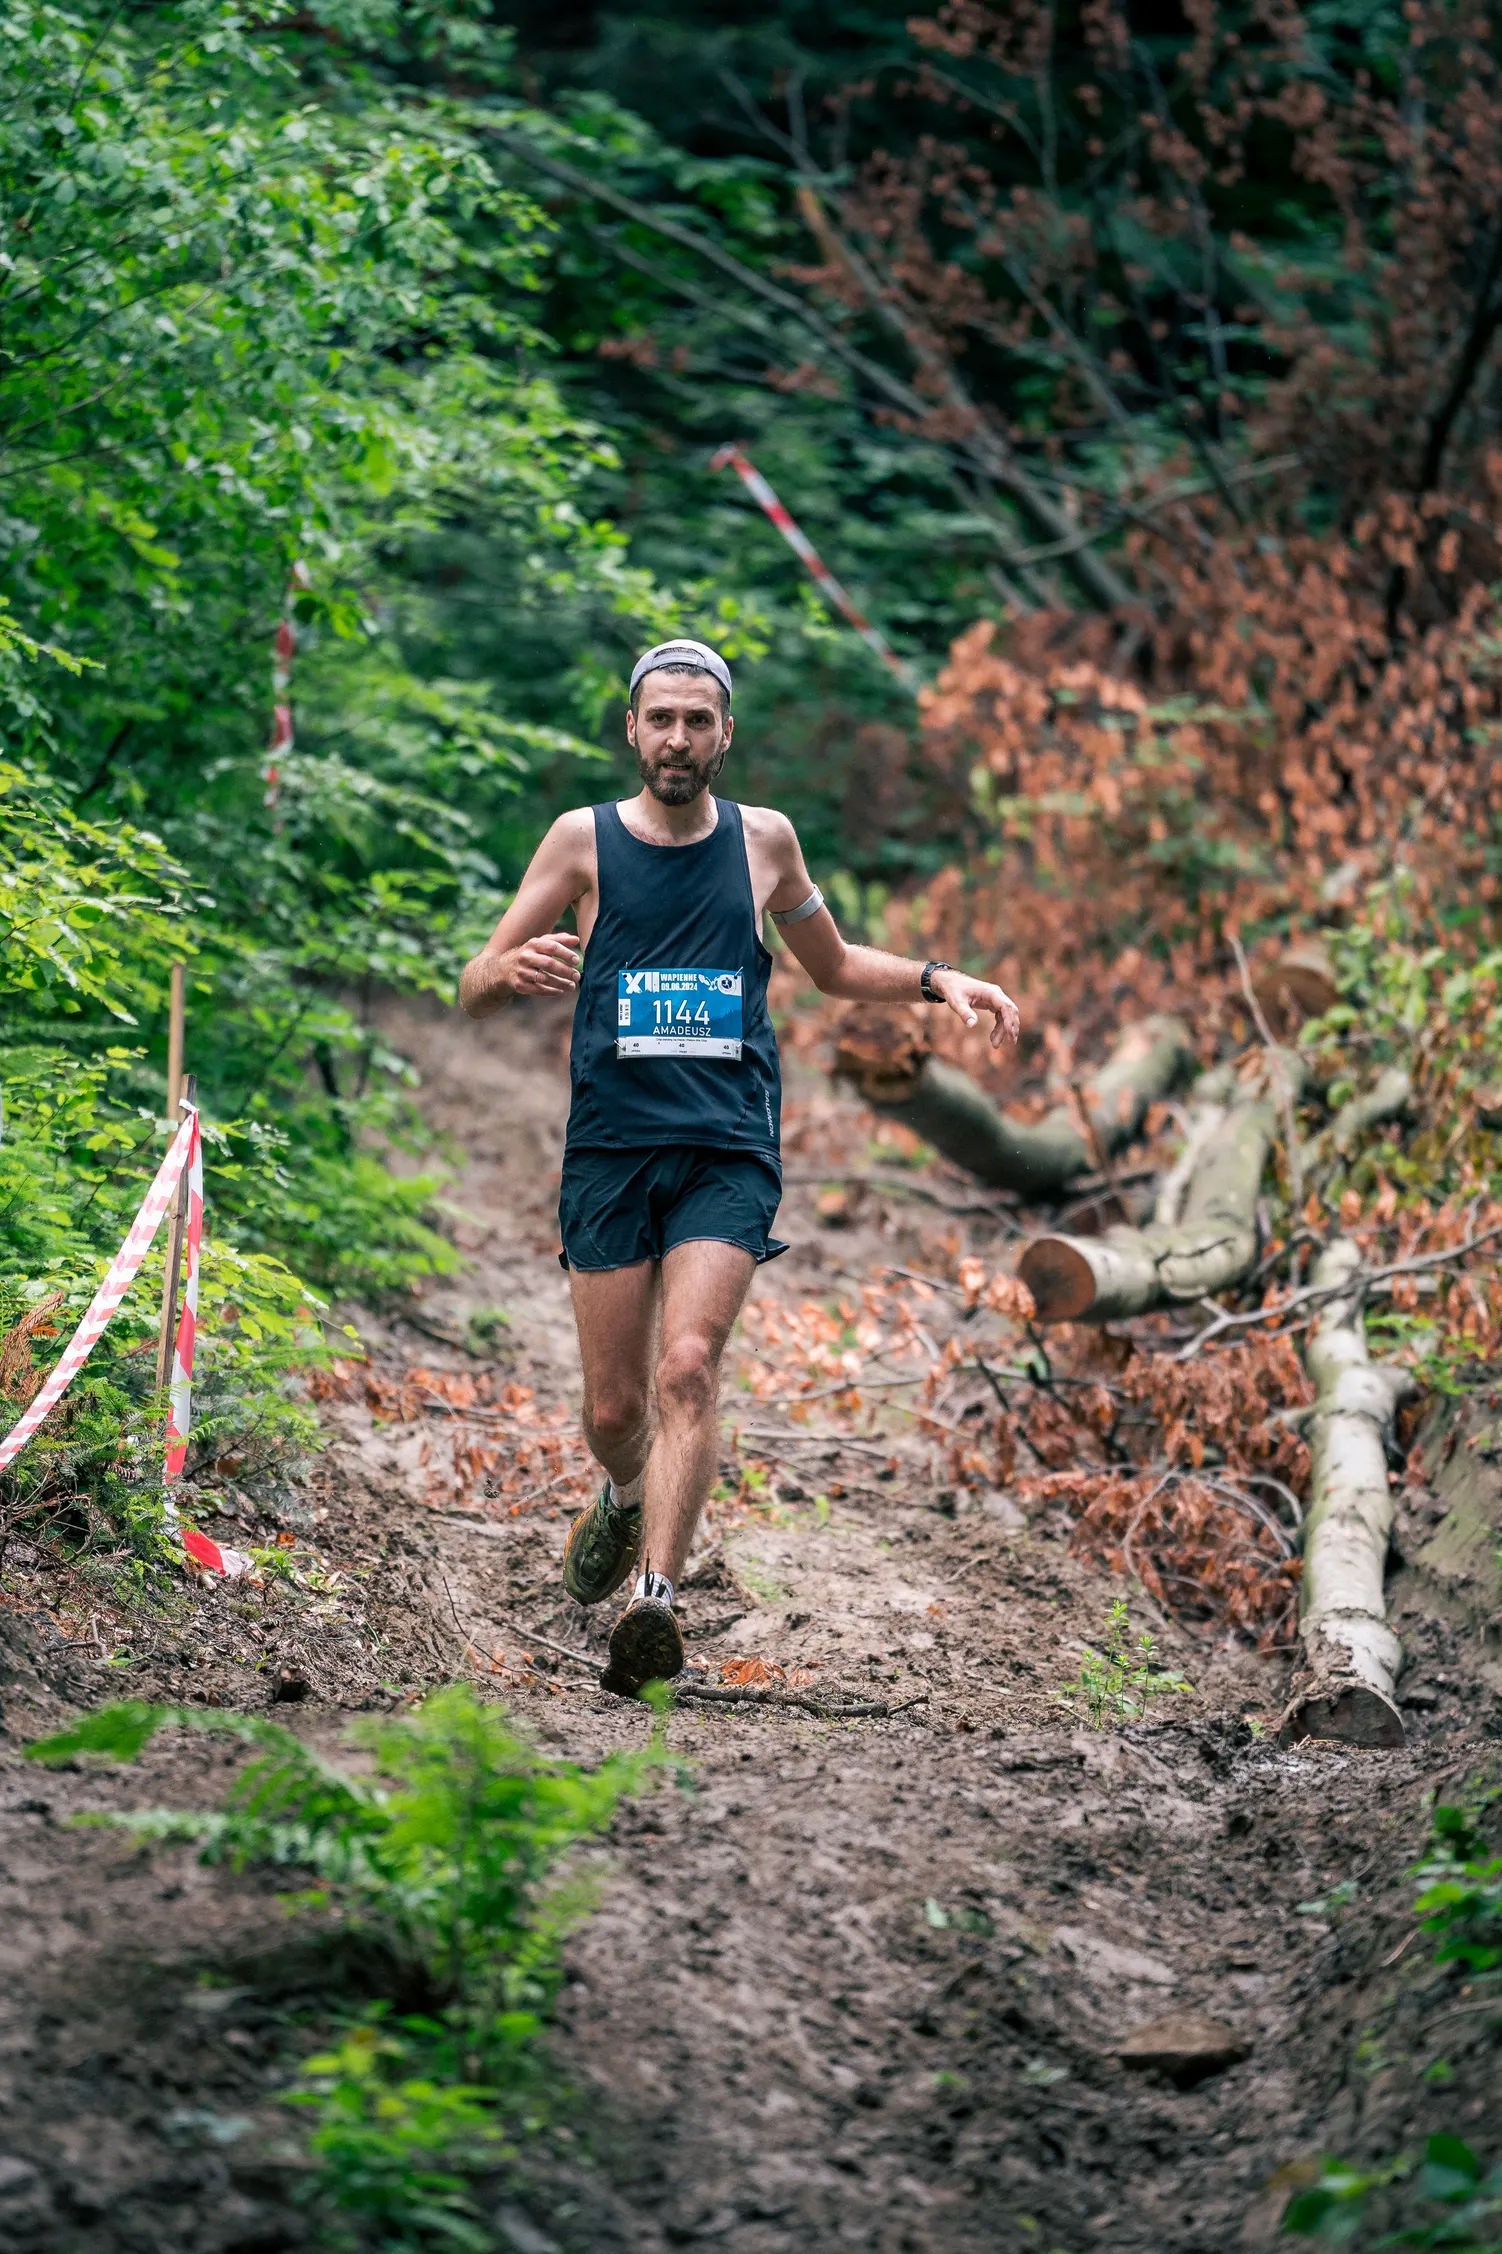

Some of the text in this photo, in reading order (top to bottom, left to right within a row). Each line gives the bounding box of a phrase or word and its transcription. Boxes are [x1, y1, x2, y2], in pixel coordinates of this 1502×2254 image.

[660, 973, 698, 982] WAPIENNE
[653, 1000, 711, 1025] 1144
[653, 1026, 711, 1037] AMADEUSZ
[764, 1089, 775, 1138] SALOMON
